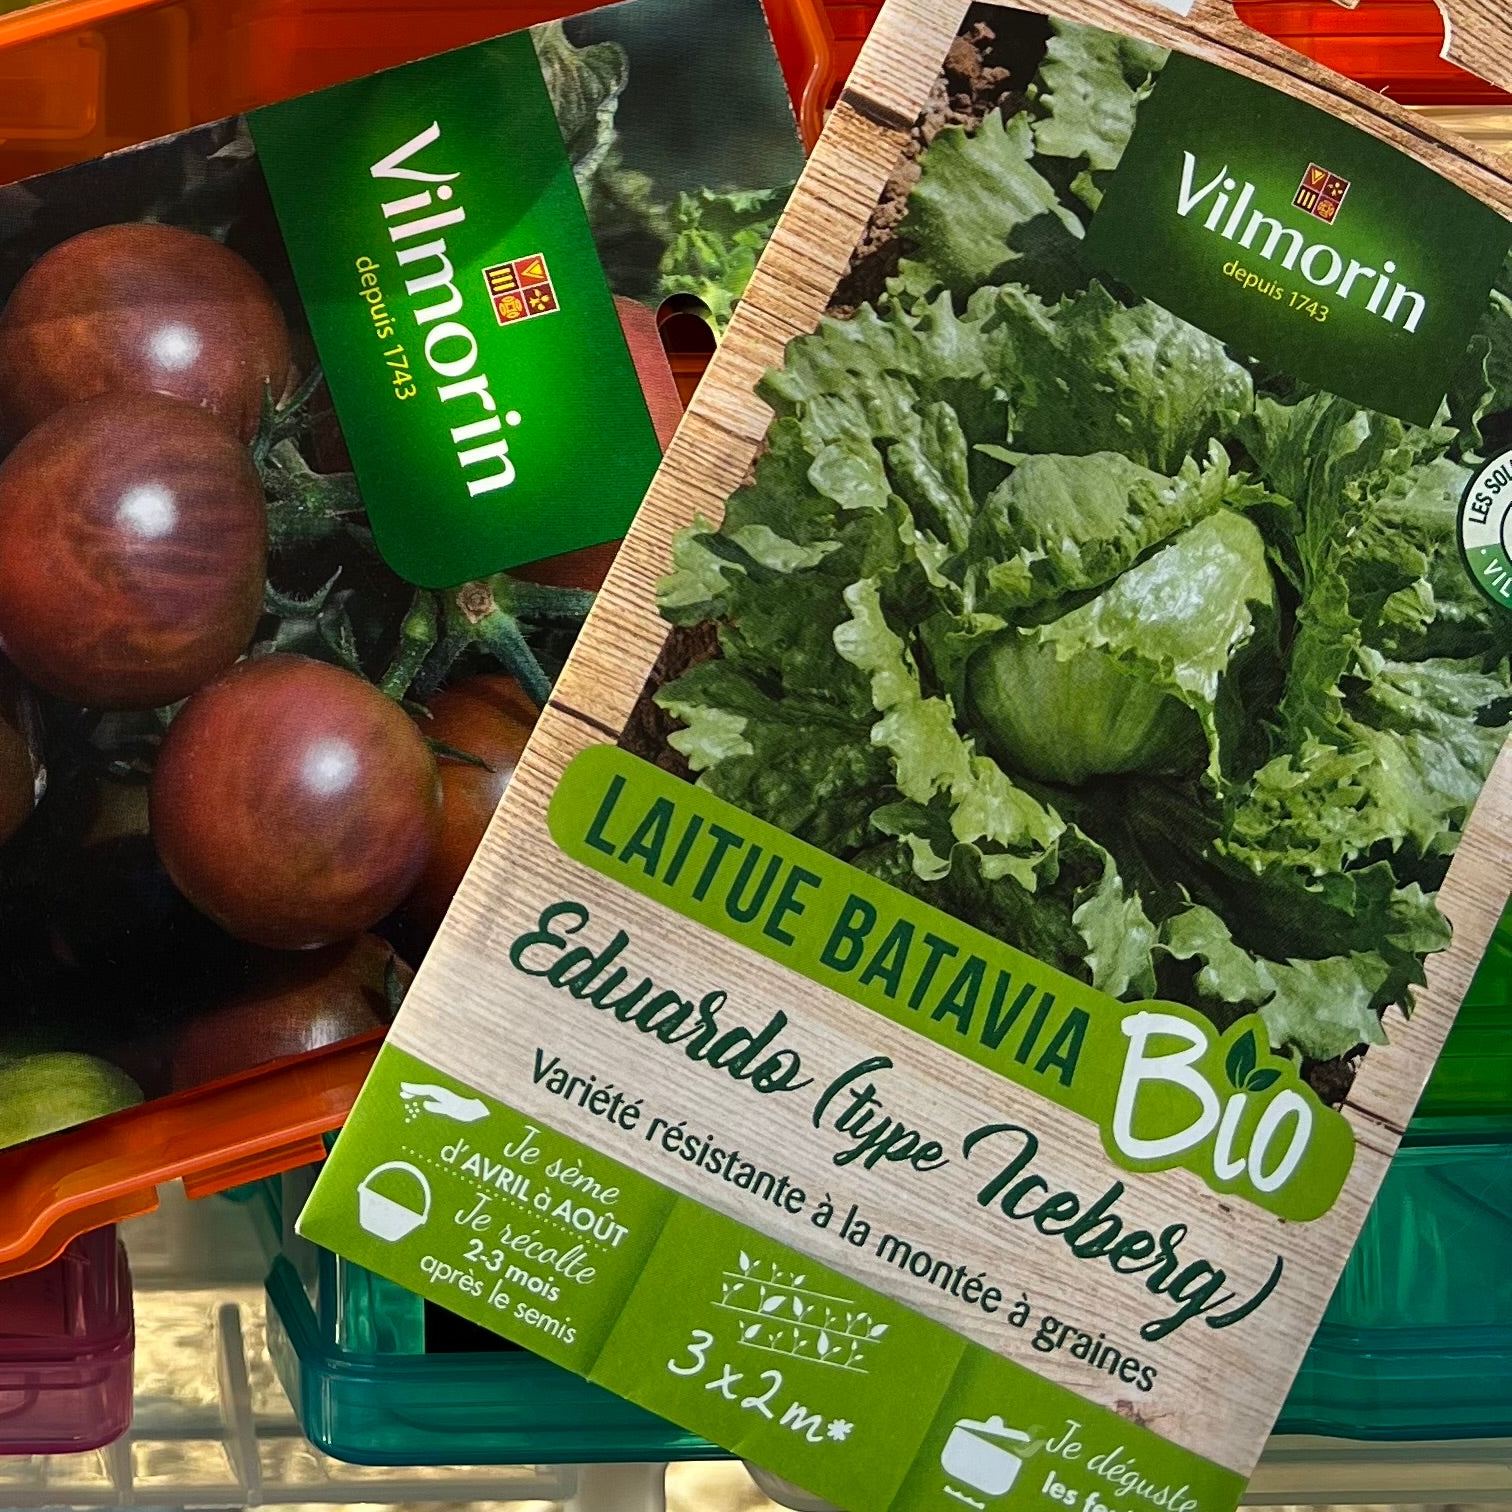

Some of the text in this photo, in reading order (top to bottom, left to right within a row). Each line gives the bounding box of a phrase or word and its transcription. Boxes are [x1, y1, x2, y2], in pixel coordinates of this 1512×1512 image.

[1175, 150, 1428, 334] Vilmorin
[1222, 259, 1329, 322] depuis 1743
[355, 254, 417, 400] depuis 1743
[369, 120, 521, 498] Vilmorin
[1468, 491, 1493, 525] LES
[583, 773, 1090, 1088] LAITUE BATAVIA
[508, 900, 1283, 1342] Eduardo (type Iceberg)
[1111, 1010, 1314, 1192] Bio
[439, 1138, 629, 1247] d'AVRIL à AOÛT
[502, 1124, 620, 1205] Je sème
[454, 1191, 596, 1284] Je récolte
[462, 1238, 560, 1301] 2-3 mois
[532, 1047, 1157, 1392] Variété résistante à la montée à graines
[419, 1255, 576, 1344] après le semis
[1041, 1470, 1078, 1505] les
[1043, 1418, 1197, 1512] Je déguste
